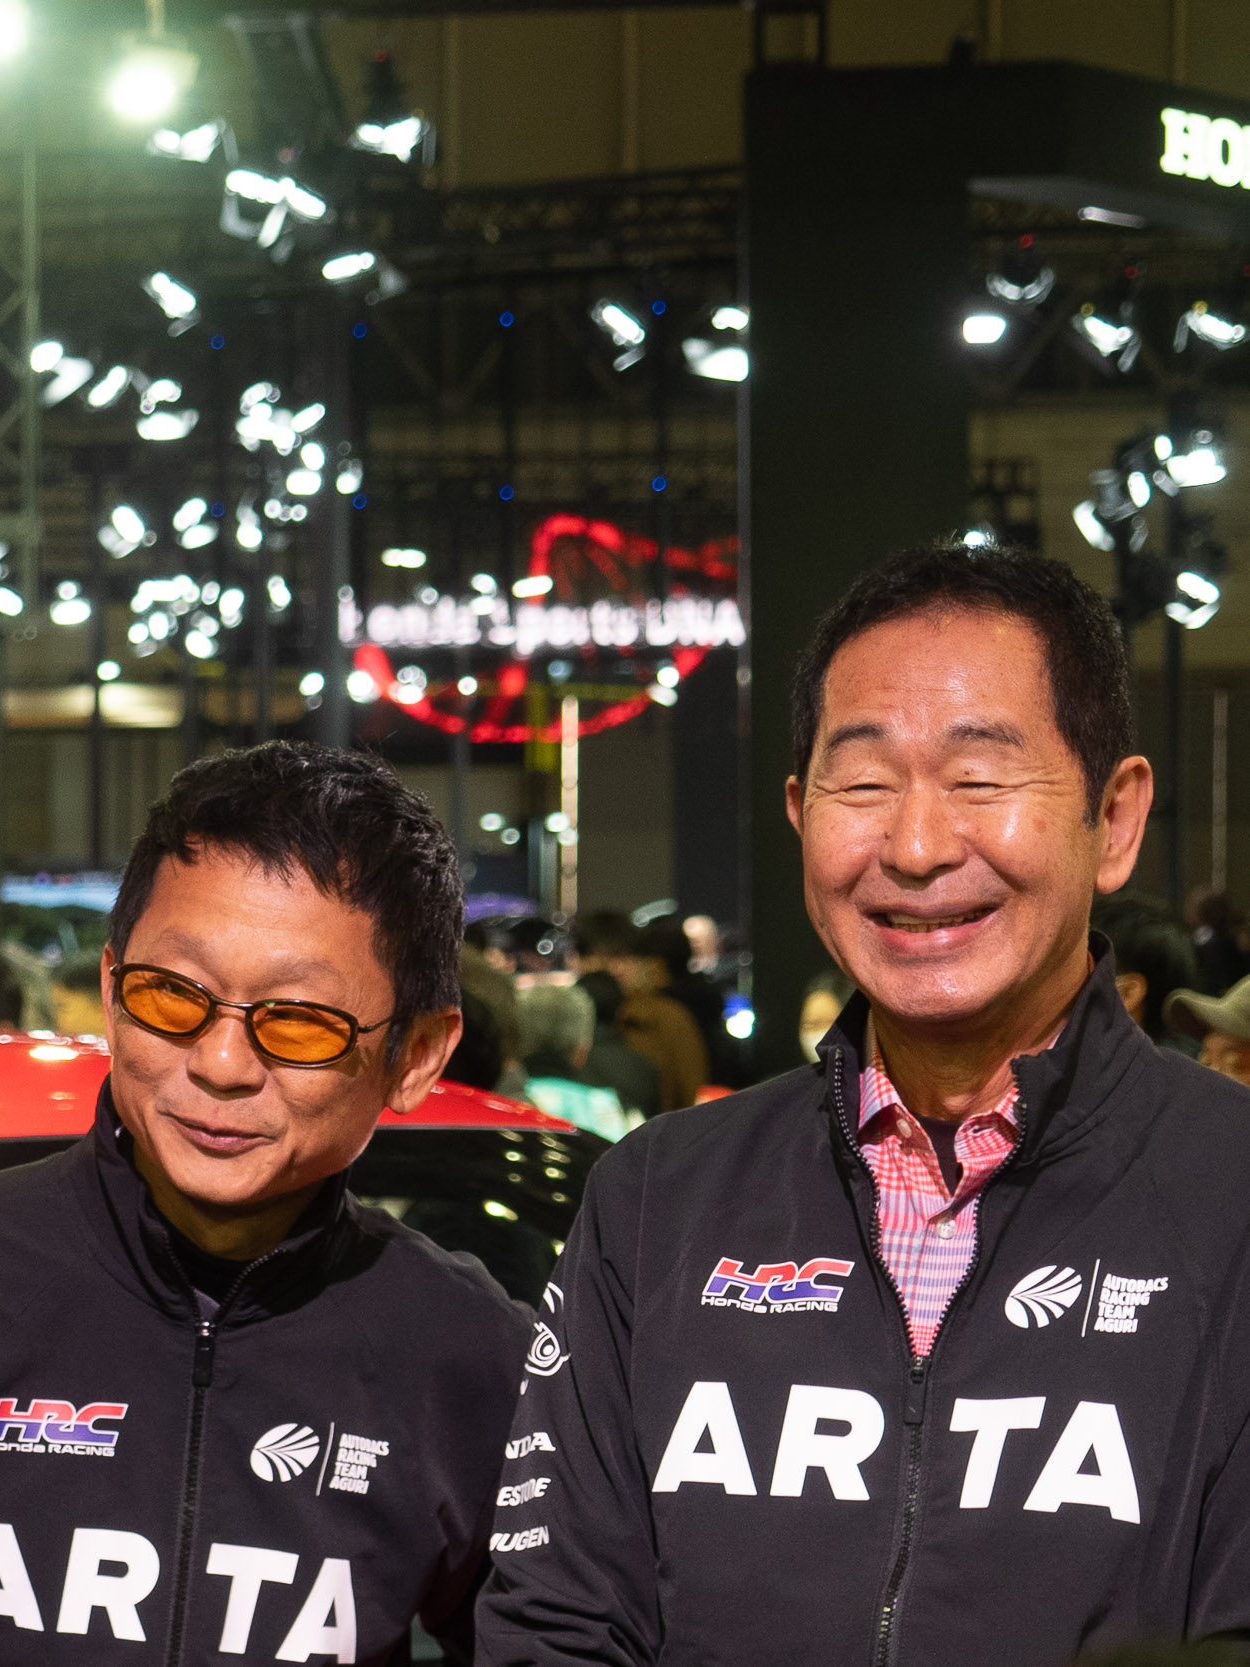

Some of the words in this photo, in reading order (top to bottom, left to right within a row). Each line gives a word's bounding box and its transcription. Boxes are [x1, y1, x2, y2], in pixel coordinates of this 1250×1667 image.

[1160, 107, 1250, 190] HO
[702, 1257, 855, 1304] HRC
[1102, 1273, 1169, 1292] AUTOBACS
[701, 1296, 767, 1314] Honda
[769, 1301, 838, 1314] RACING
[1100, 1287, 1150, 1306] RACING
[1098, 1301, 1136, 1319] TEAM
[1093, 1316, 1139, 1333] AGURI
[48, 1443, 116, 1457] RACING
[339, 1433, 390, 1456] AUTOBACS
[336, 1447, 377, 1468] RACING
[334, 1461, 368, 1480] TEAM
[329, 1475, 370, 1495] AGURI
